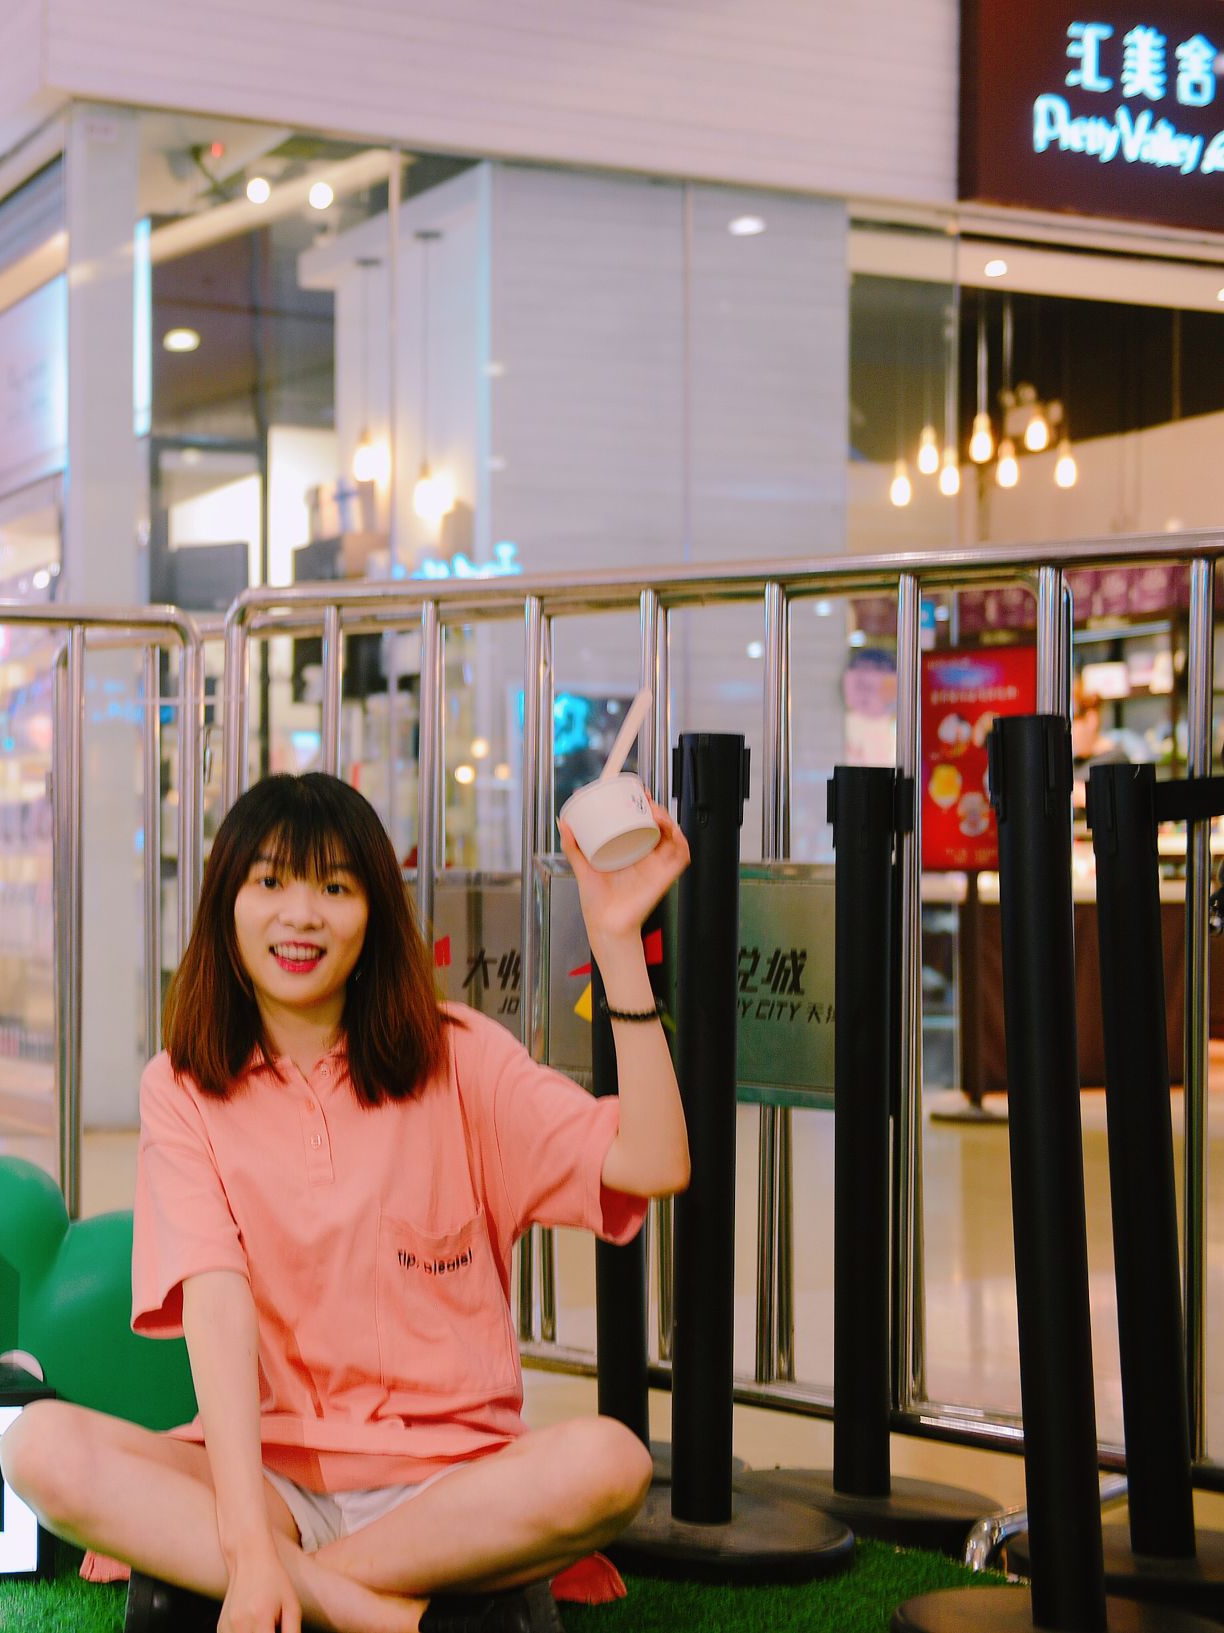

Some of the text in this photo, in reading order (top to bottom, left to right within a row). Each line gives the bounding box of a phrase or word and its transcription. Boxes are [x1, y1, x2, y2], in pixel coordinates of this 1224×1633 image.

[1064, 20, 1218, 107] 汇美舍
[497, 996, 521, 1016] JO
[755, 999, 803, 1022] CITY
